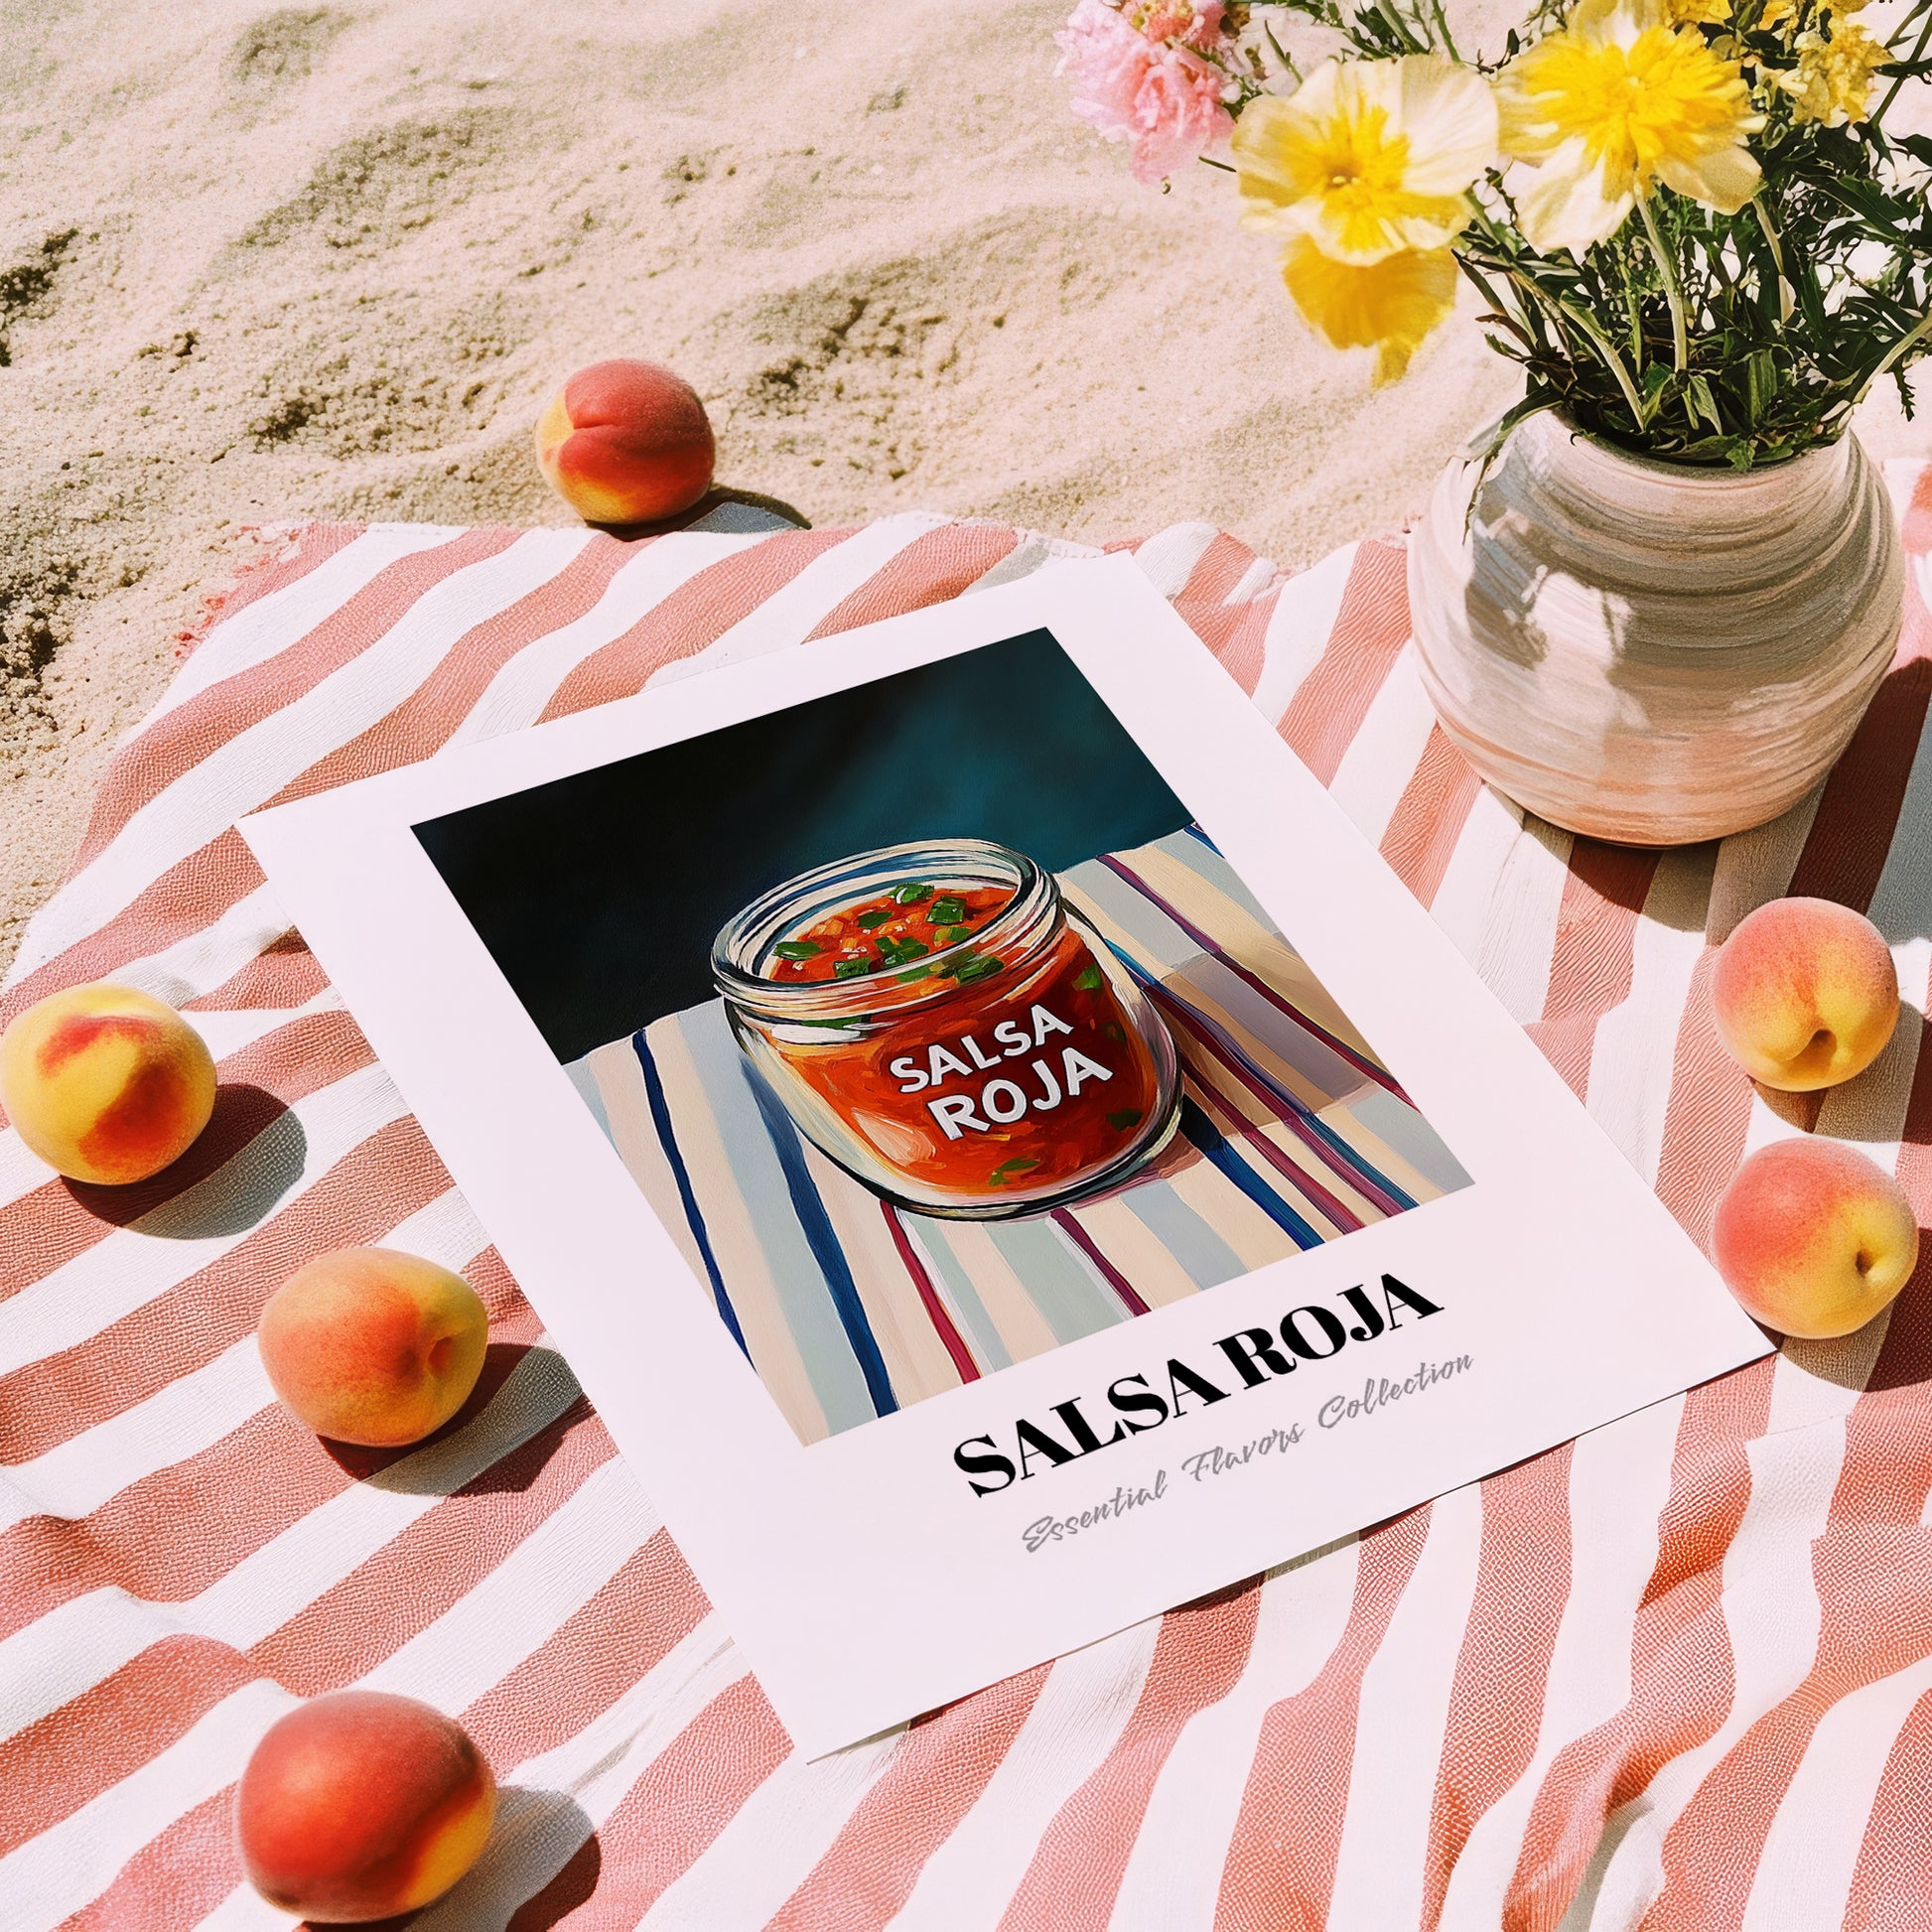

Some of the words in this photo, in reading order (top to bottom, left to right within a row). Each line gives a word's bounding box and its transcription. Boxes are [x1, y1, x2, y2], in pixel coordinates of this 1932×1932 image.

[890, 1004, 1074, 1093] SALSA
[927, 1046, 1114, 1141] ROJA
[953, 1358, 1231, 1498] SALSA
[1212, 1273, 1445, 1390] ROJA
[1022, 1469, 1169, 1553] Essential
[1181, 1422, 1305, 1482] Flavors
[1317, 1353, 1473, 1430] Collection
